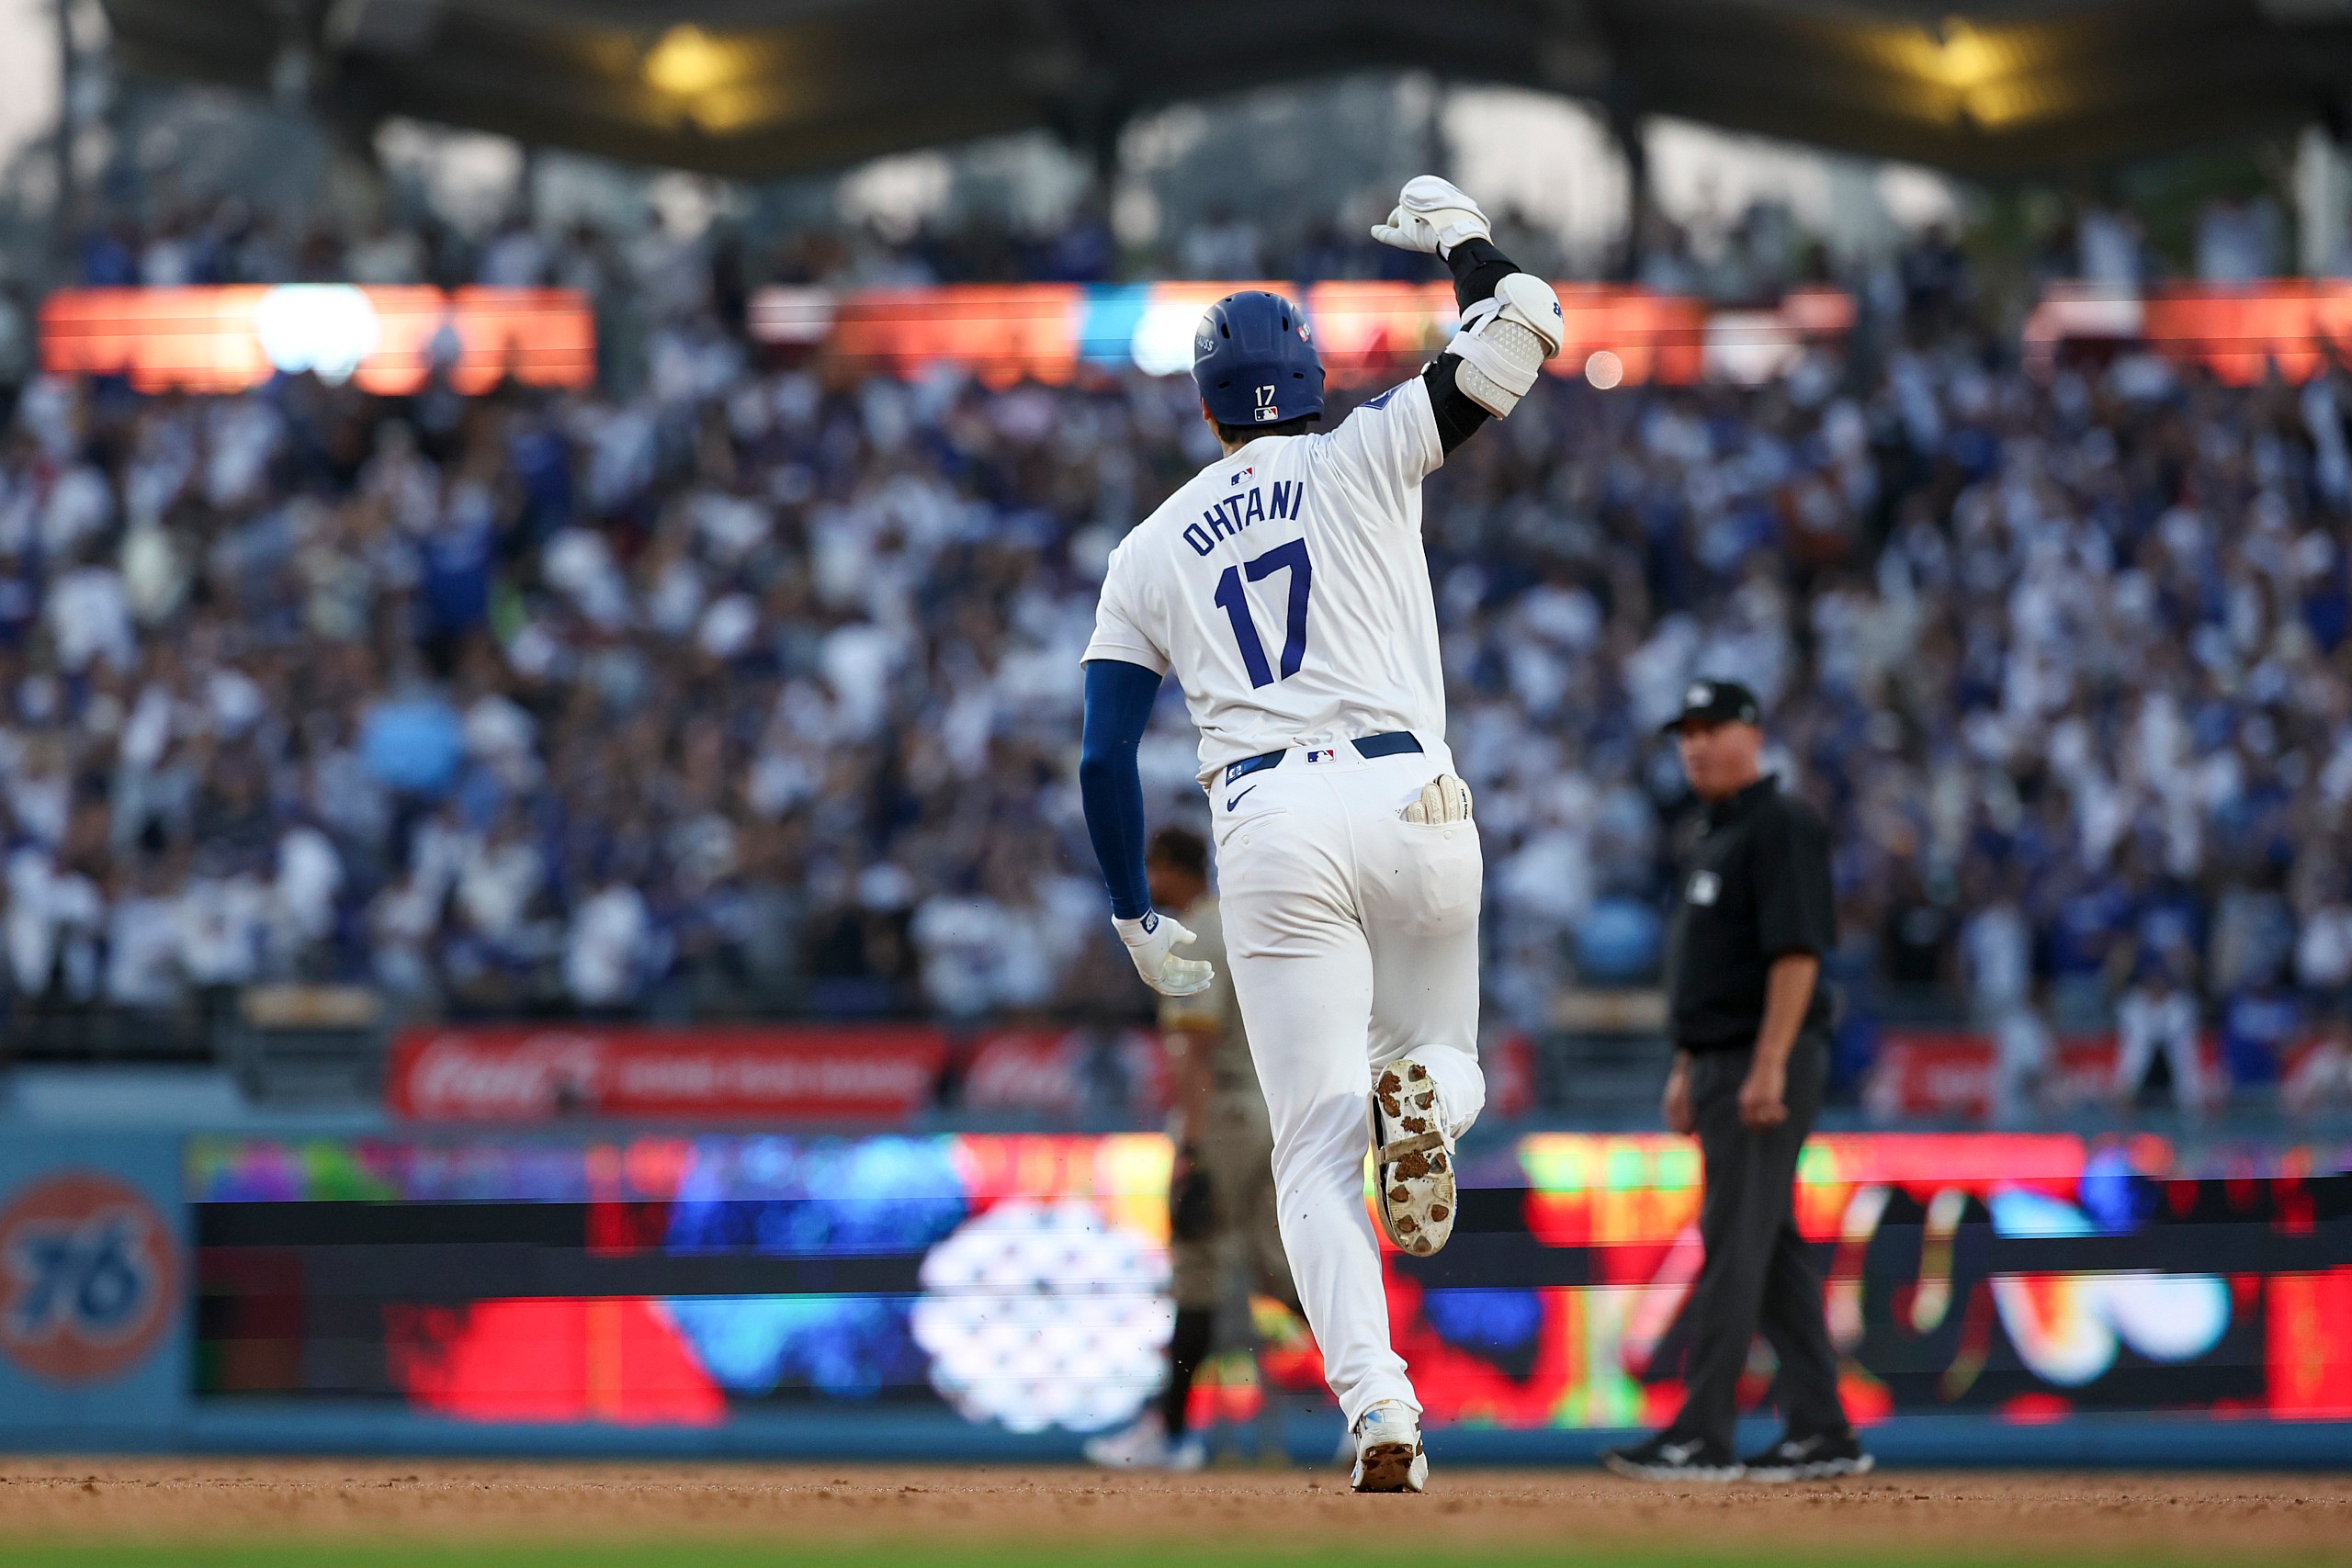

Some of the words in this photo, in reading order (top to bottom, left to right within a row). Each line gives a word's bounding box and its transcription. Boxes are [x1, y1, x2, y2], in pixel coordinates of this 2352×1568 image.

[1255, 384, 1275, 407] 17
[1182, 480, 1304, 557] OHTANI
[1214, 536, 1313, 690] 17
[17, 1218, 147, 1334] 76
